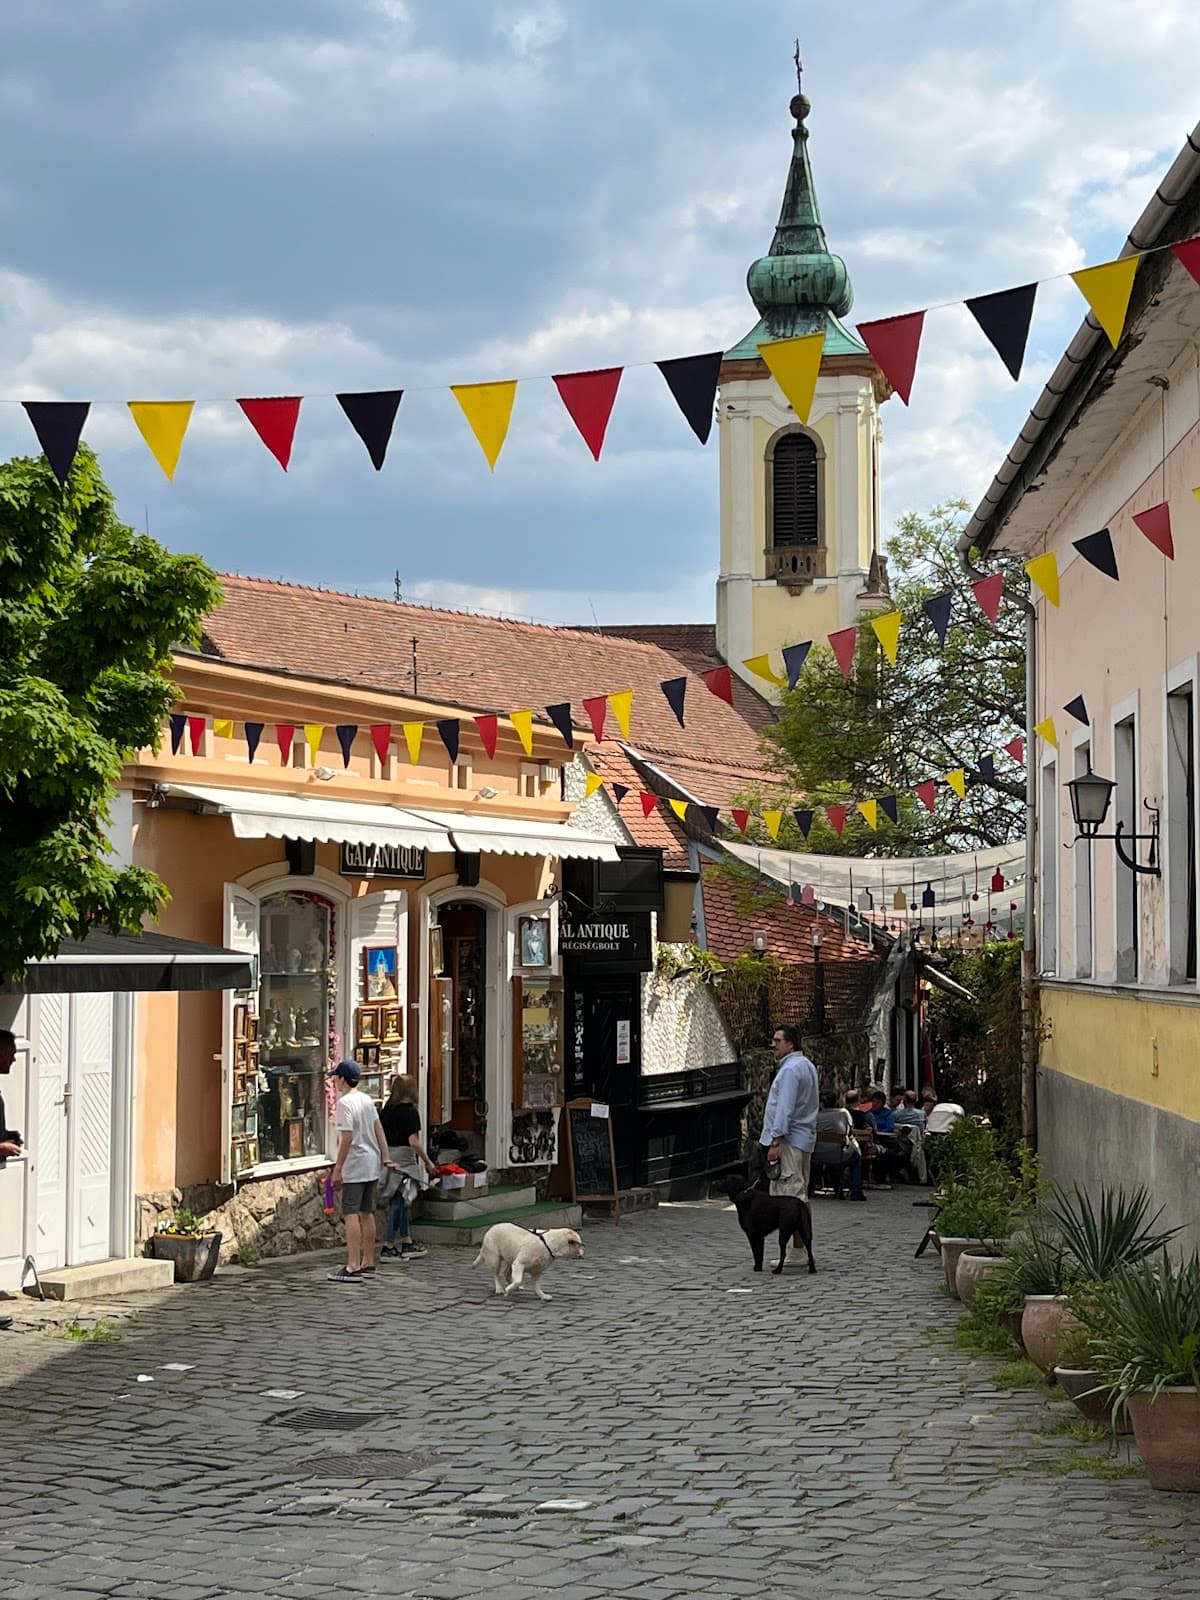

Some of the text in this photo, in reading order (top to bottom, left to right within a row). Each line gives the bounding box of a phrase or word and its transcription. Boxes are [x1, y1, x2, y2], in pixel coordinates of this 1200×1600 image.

[372, 845, 423, 873] ANTIQUE
[577, 923, 630, 940] ANTIQUE
[562, 940, 621, 951] RÉGISÉGBOLT
